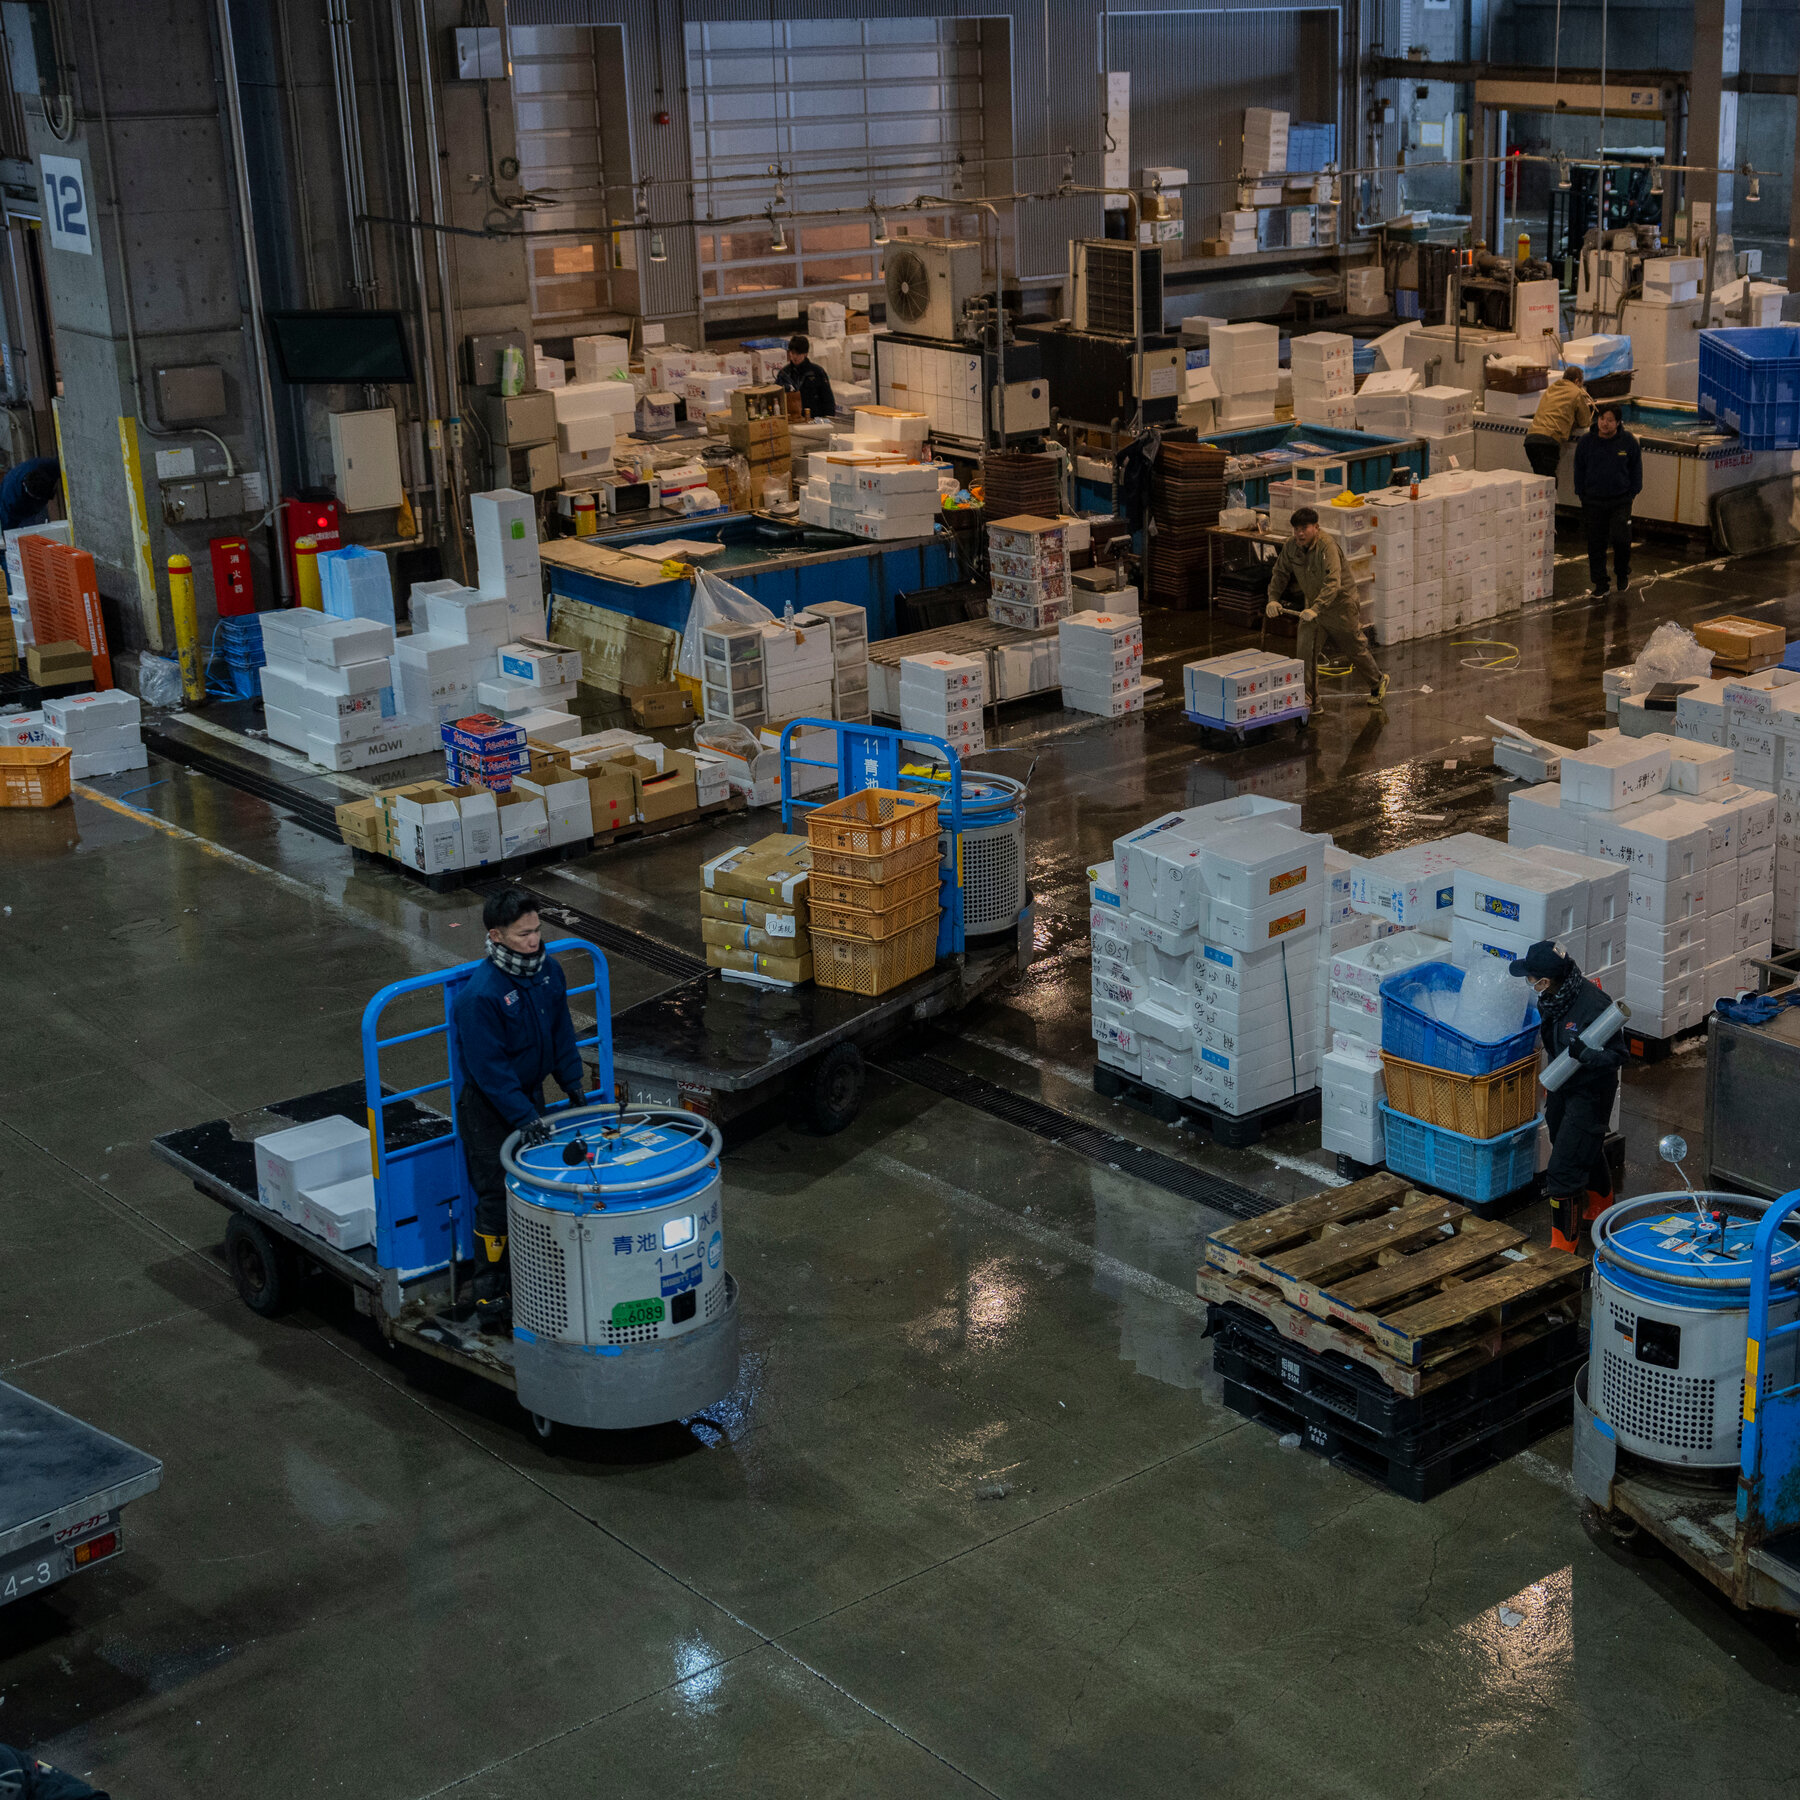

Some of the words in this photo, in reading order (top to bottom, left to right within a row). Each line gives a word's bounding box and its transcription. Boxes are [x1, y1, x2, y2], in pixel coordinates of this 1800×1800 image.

[45, 173, 87, 236] 12
[368, 739, 403, 756] MOWI
[863, 737, 879, 756] 11
[612, 1232, 657, 1256] 青池
[655, 1240, 706, 1274] 11-6
[628, 1305, 663, 1324] 6089
[4, 1562, 51, 1597] 4-3
